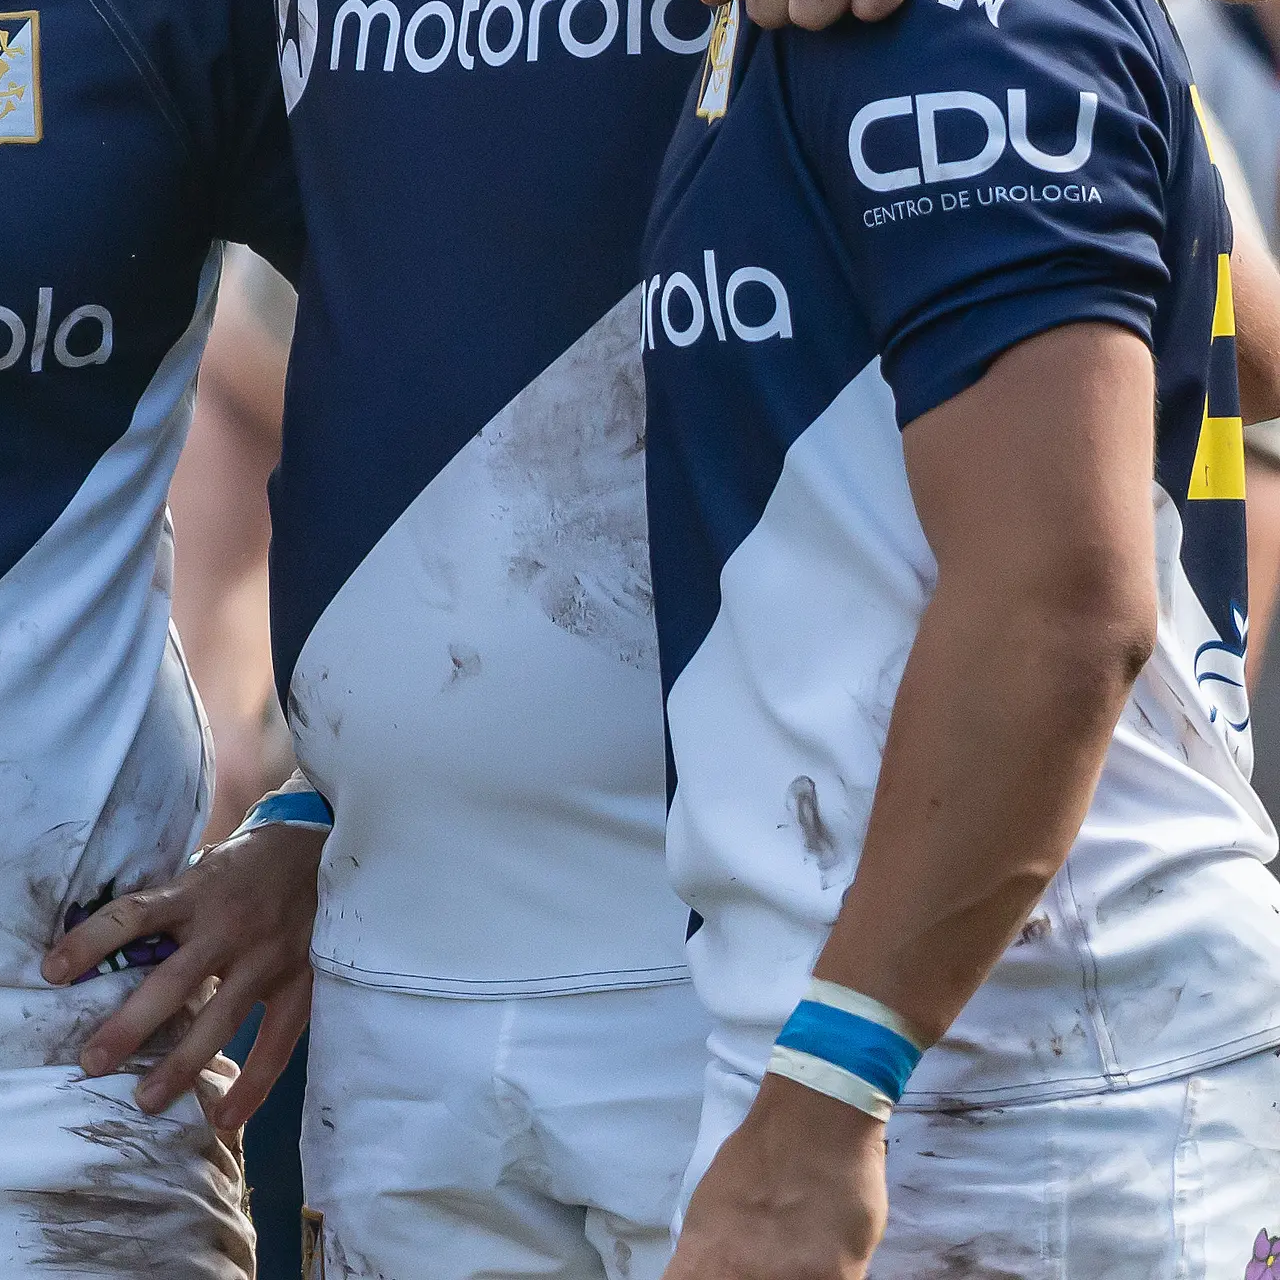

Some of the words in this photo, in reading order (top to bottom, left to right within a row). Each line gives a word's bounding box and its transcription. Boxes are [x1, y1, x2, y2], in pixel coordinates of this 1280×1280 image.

[848, 88, 1098, 192] CDU
[863, 196, 934, 229] CENTRO
[940, 190, 971, 212] DE
[977, 184, 1103, 207] UROLOGIA
[640, 249, 793, 355] rola
